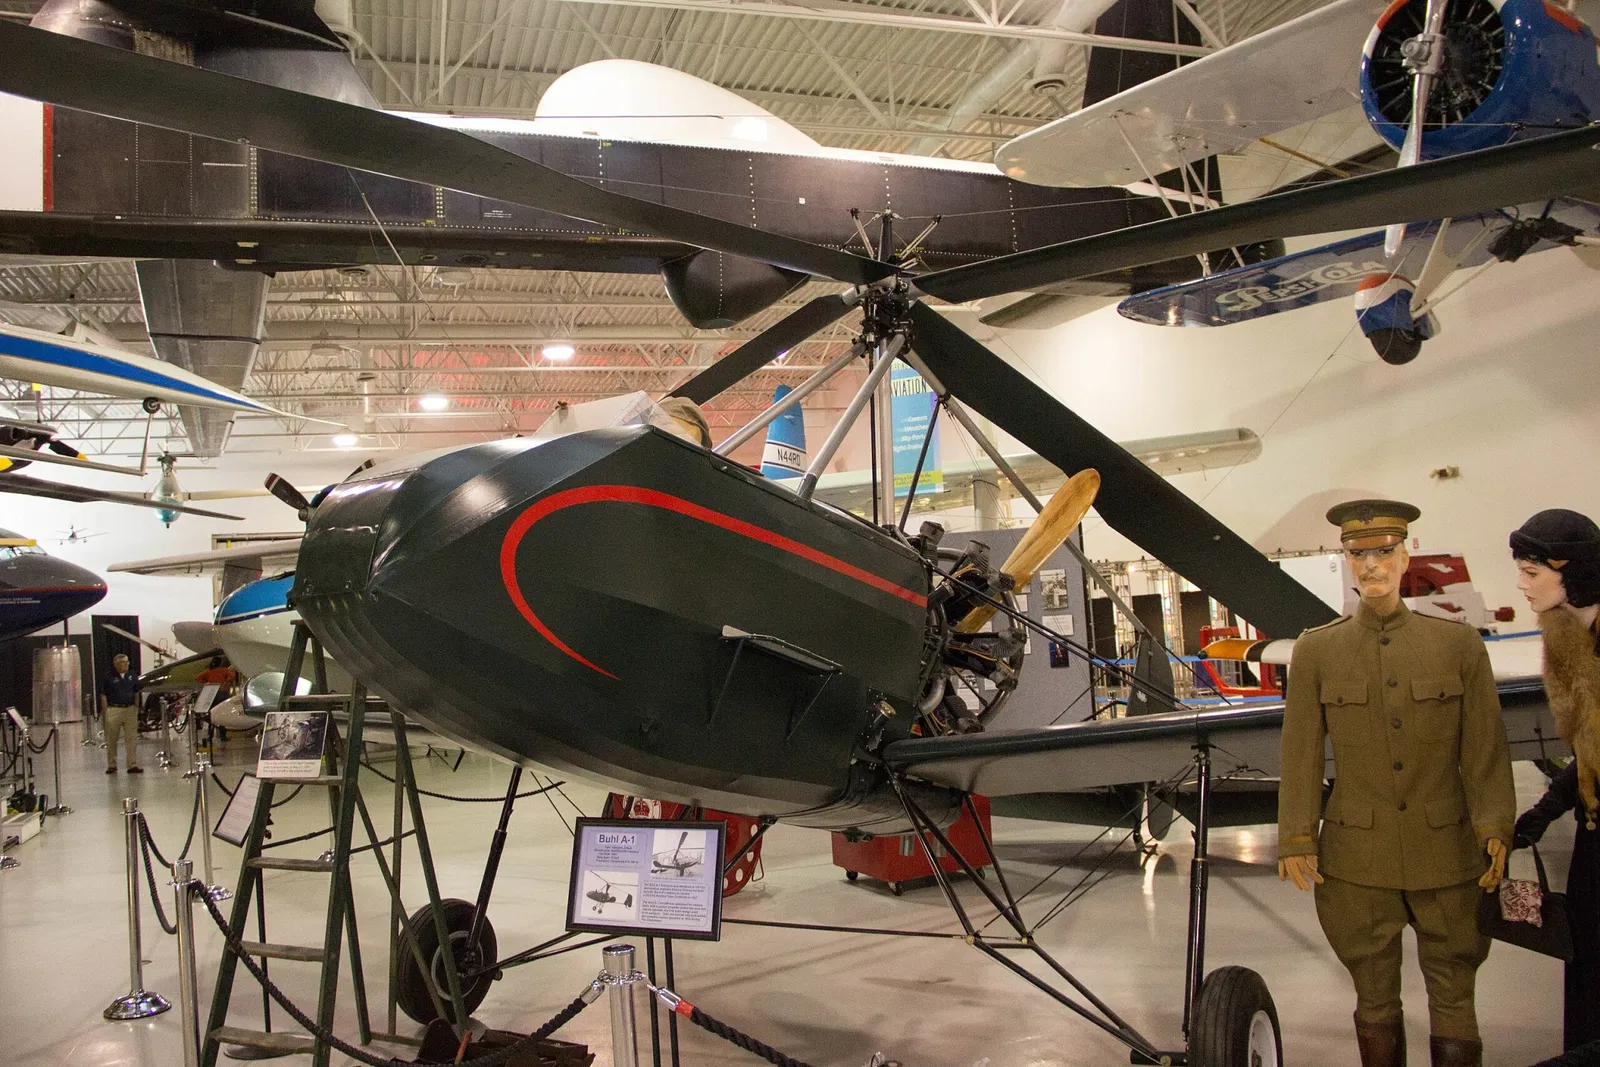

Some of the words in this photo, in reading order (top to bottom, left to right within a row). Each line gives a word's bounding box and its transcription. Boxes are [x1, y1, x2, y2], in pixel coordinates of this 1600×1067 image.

[892, 378, 927, 397] VIATION
[777, 448, 801, 466] N44RD
[599, 834, 619, 843] Buhl
[620, 835, 635, 844] A-1
